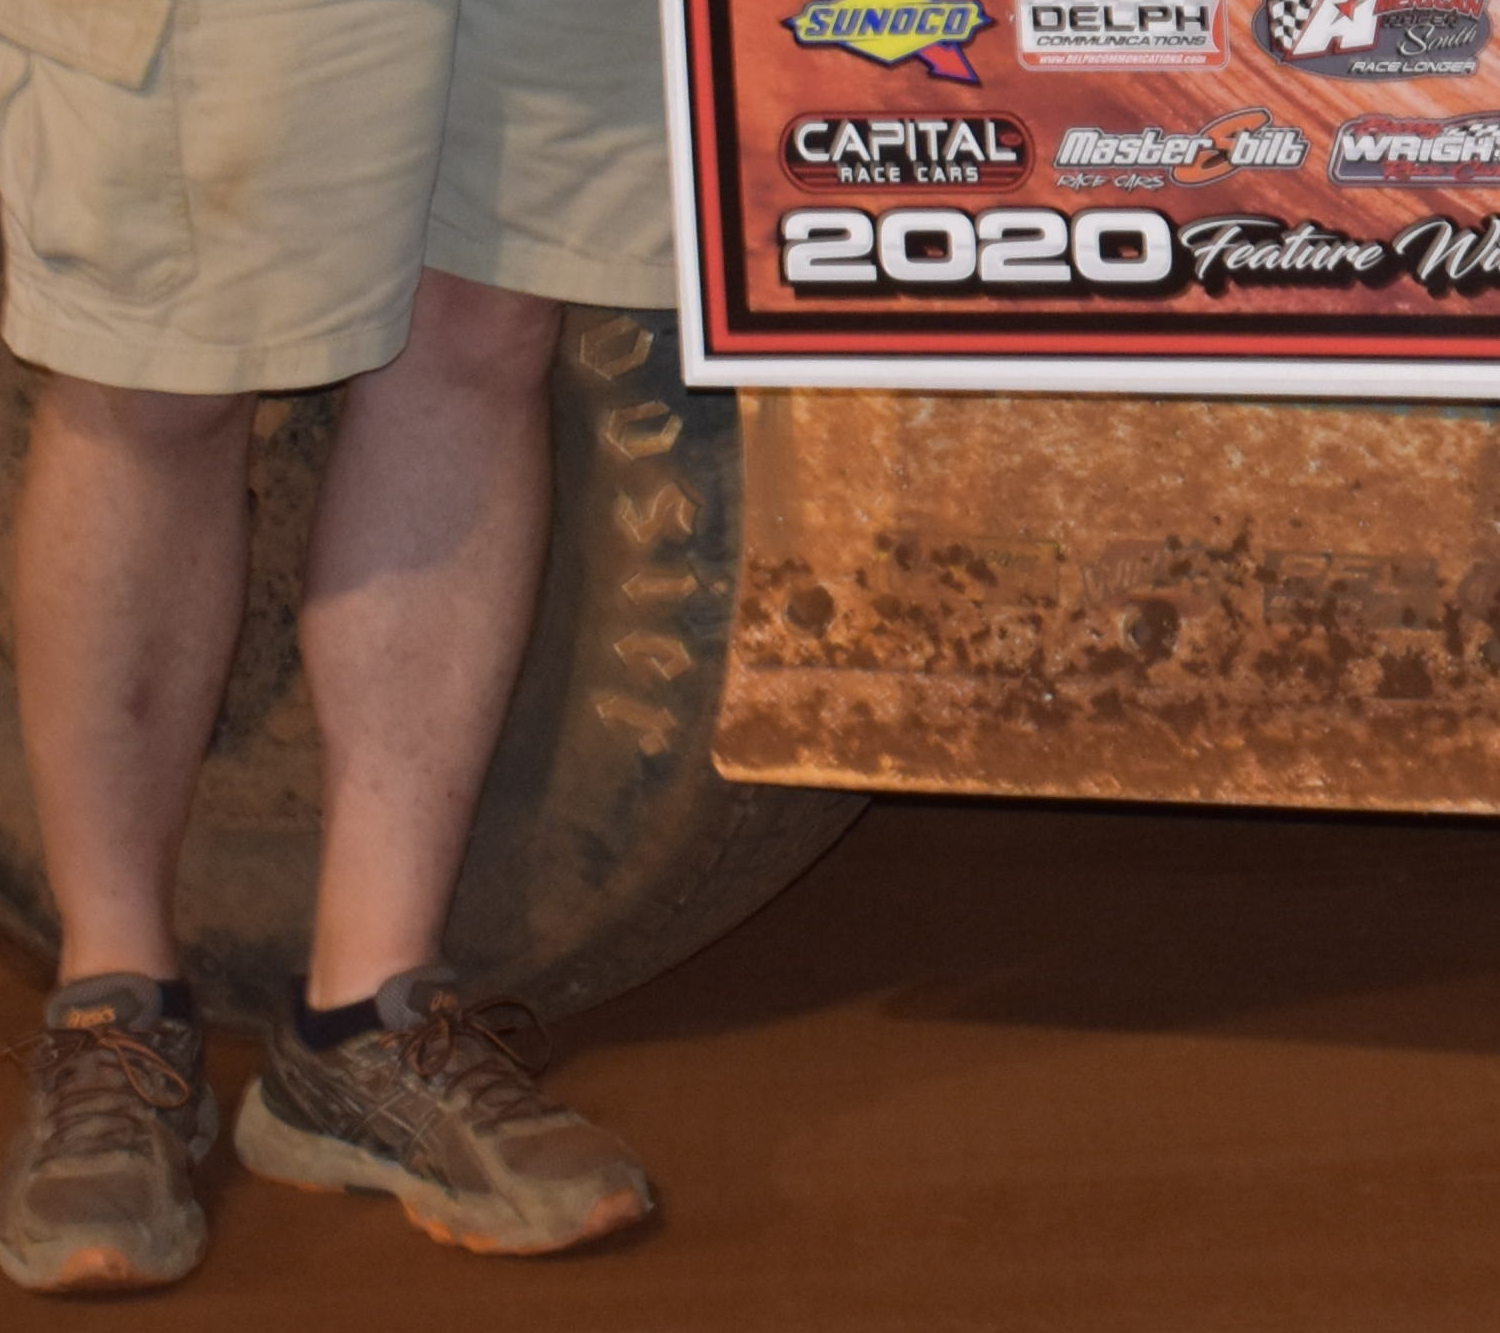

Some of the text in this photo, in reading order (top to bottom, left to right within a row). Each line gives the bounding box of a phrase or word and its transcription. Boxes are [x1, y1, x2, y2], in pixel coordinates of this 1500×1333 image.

[805, 5, 975, 38] SUNOCO
[1030, 4, 1211, 32] DELPH
[1382, 12, 1458, 30] RACER
[1036, 35, 1207, 47] COMMUNICATIONS
[1398, 23, 1479, 58] South
[1350, 59, 1476, 75] RACE LONGER
[792, 120, 1019, 164] CAPITAL
[838, 164, 981, 184] RACE CARS
[1055, 173, 1167, 192] RACE CARS
[781, 207, 1175, 285] 2020
[1177, 213, 1387, 282] Feature
